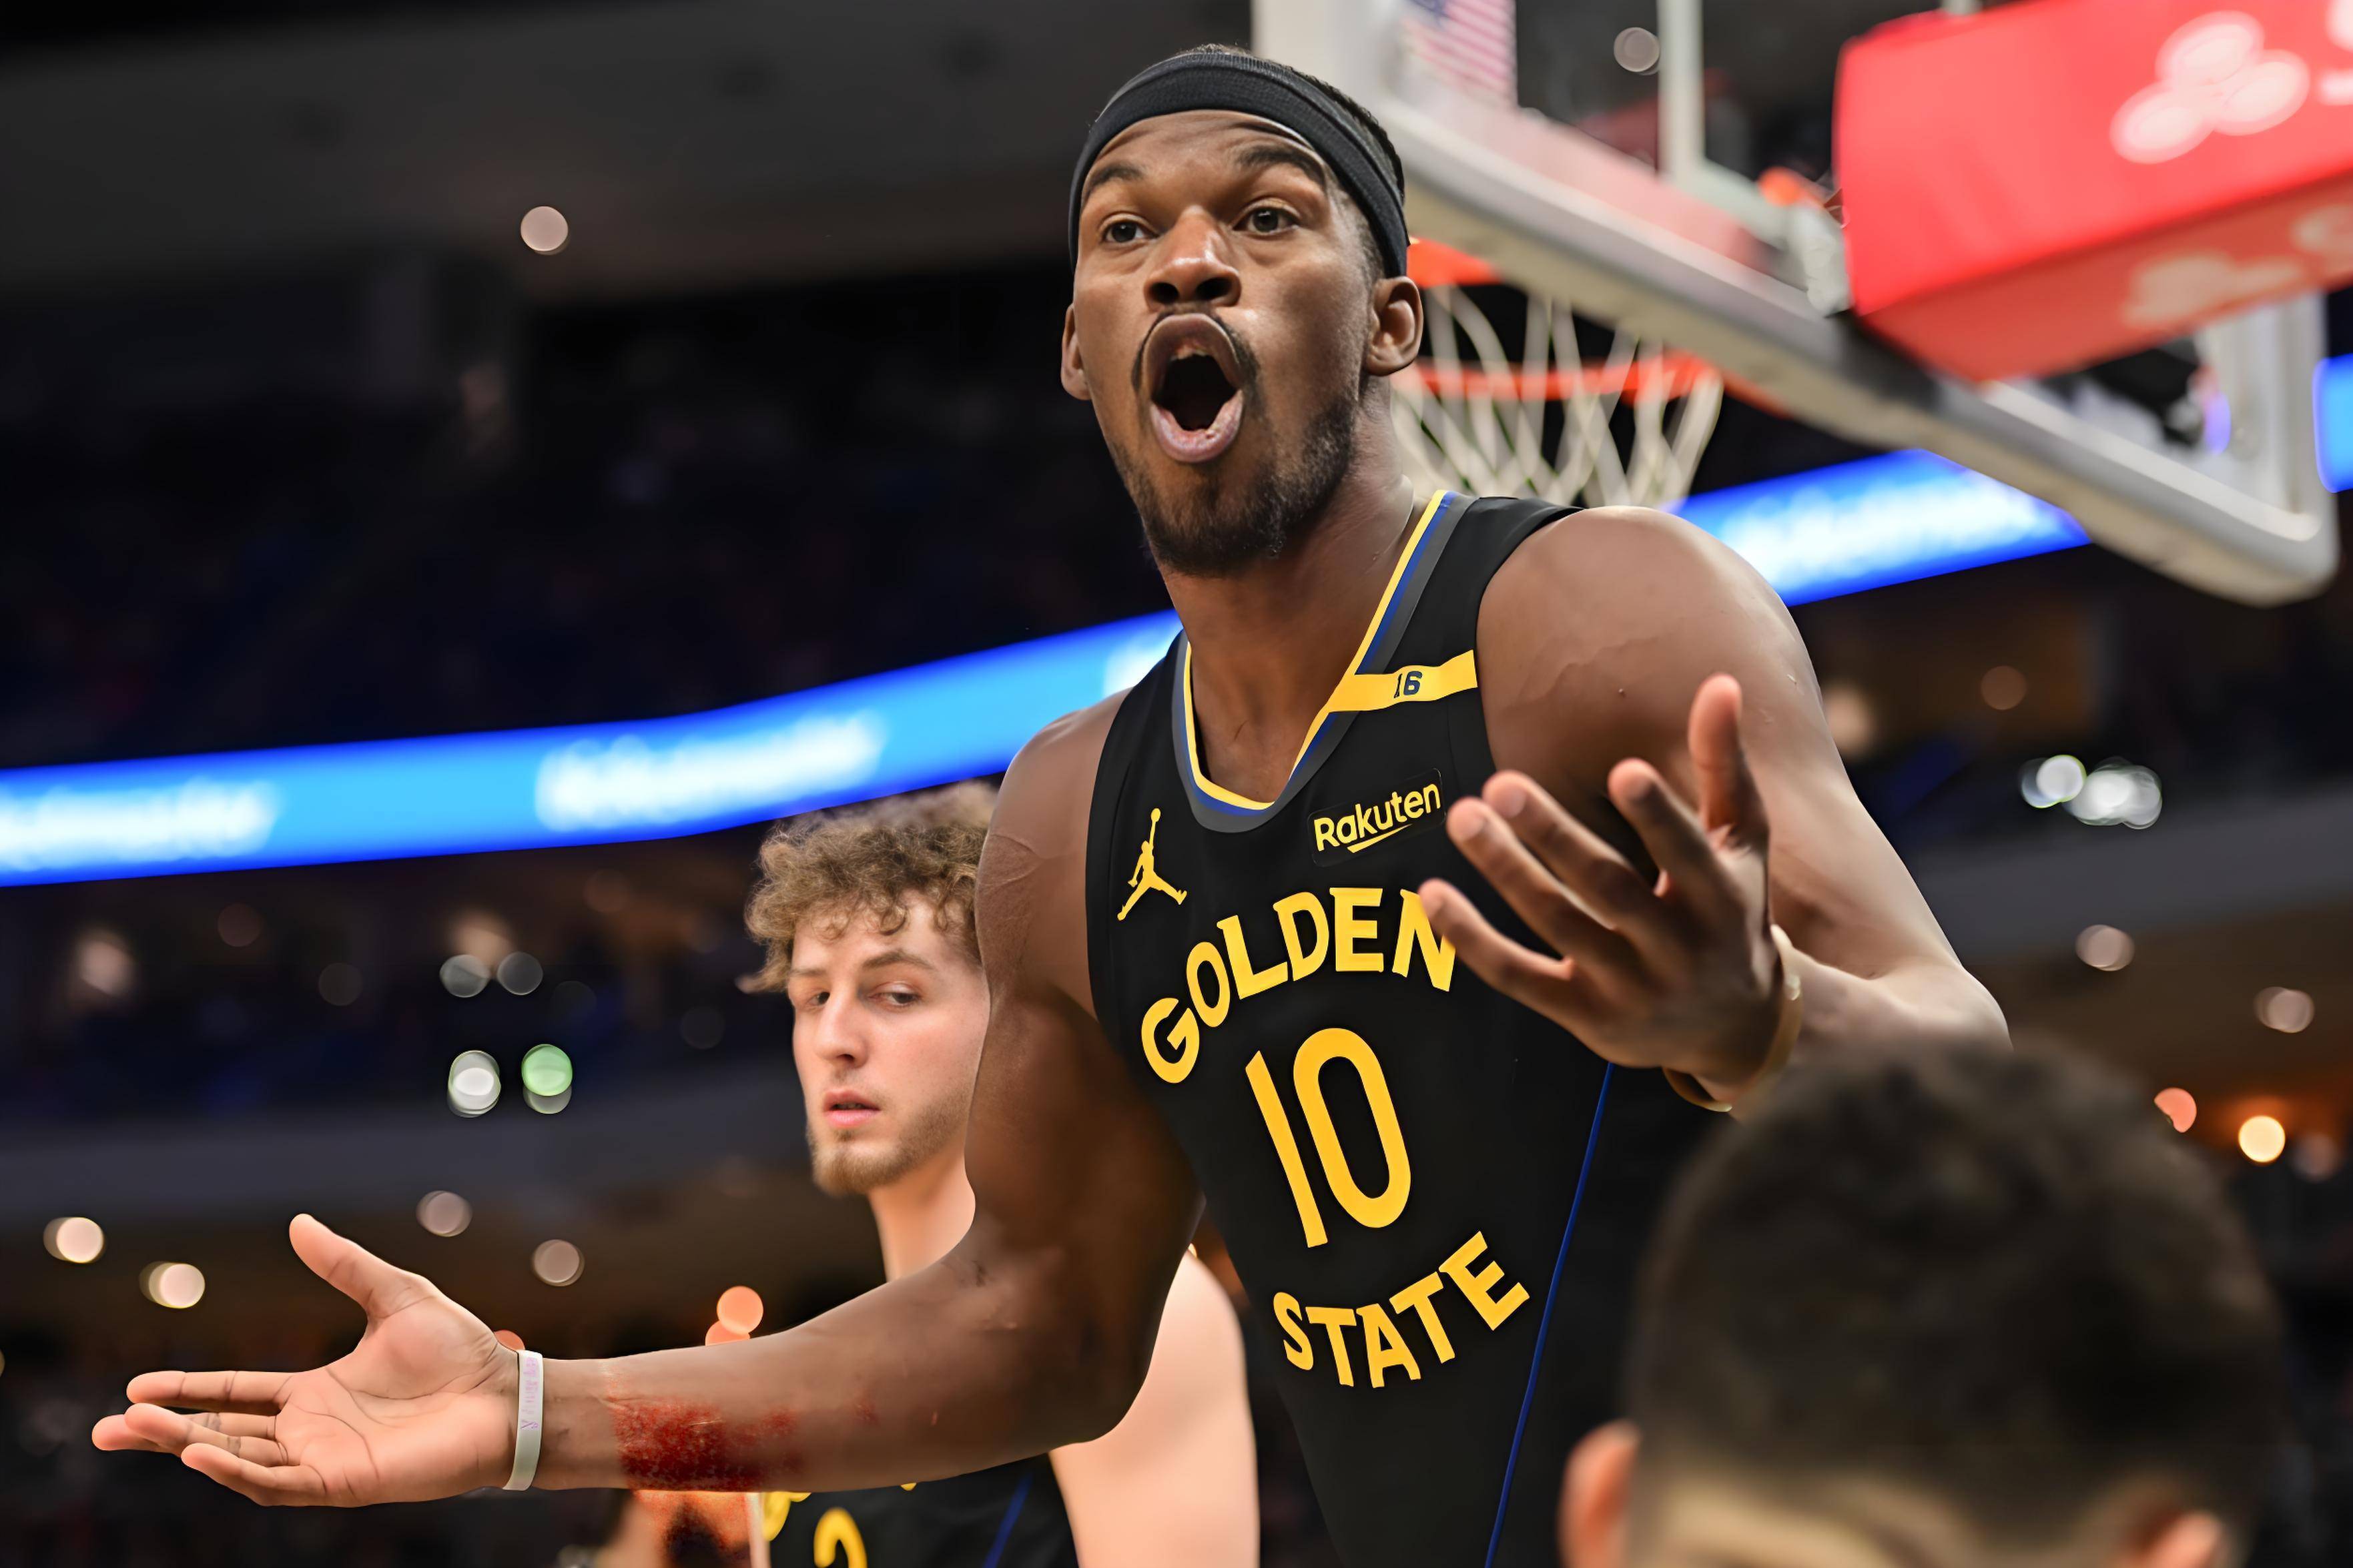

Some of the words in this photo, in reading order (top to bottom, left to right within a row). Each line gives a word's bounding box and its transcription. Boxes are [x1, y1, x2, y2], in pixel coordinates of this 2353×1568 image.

[1393, 671, 1422, 699] 16
[1314, 783, 1441, 851] Rakuten
[1141, 887, 1455, 1084] GOLDEN
[1245, 1028, 1411, 1248] 10
[1273, 1230, 1530, 1388] STATE
